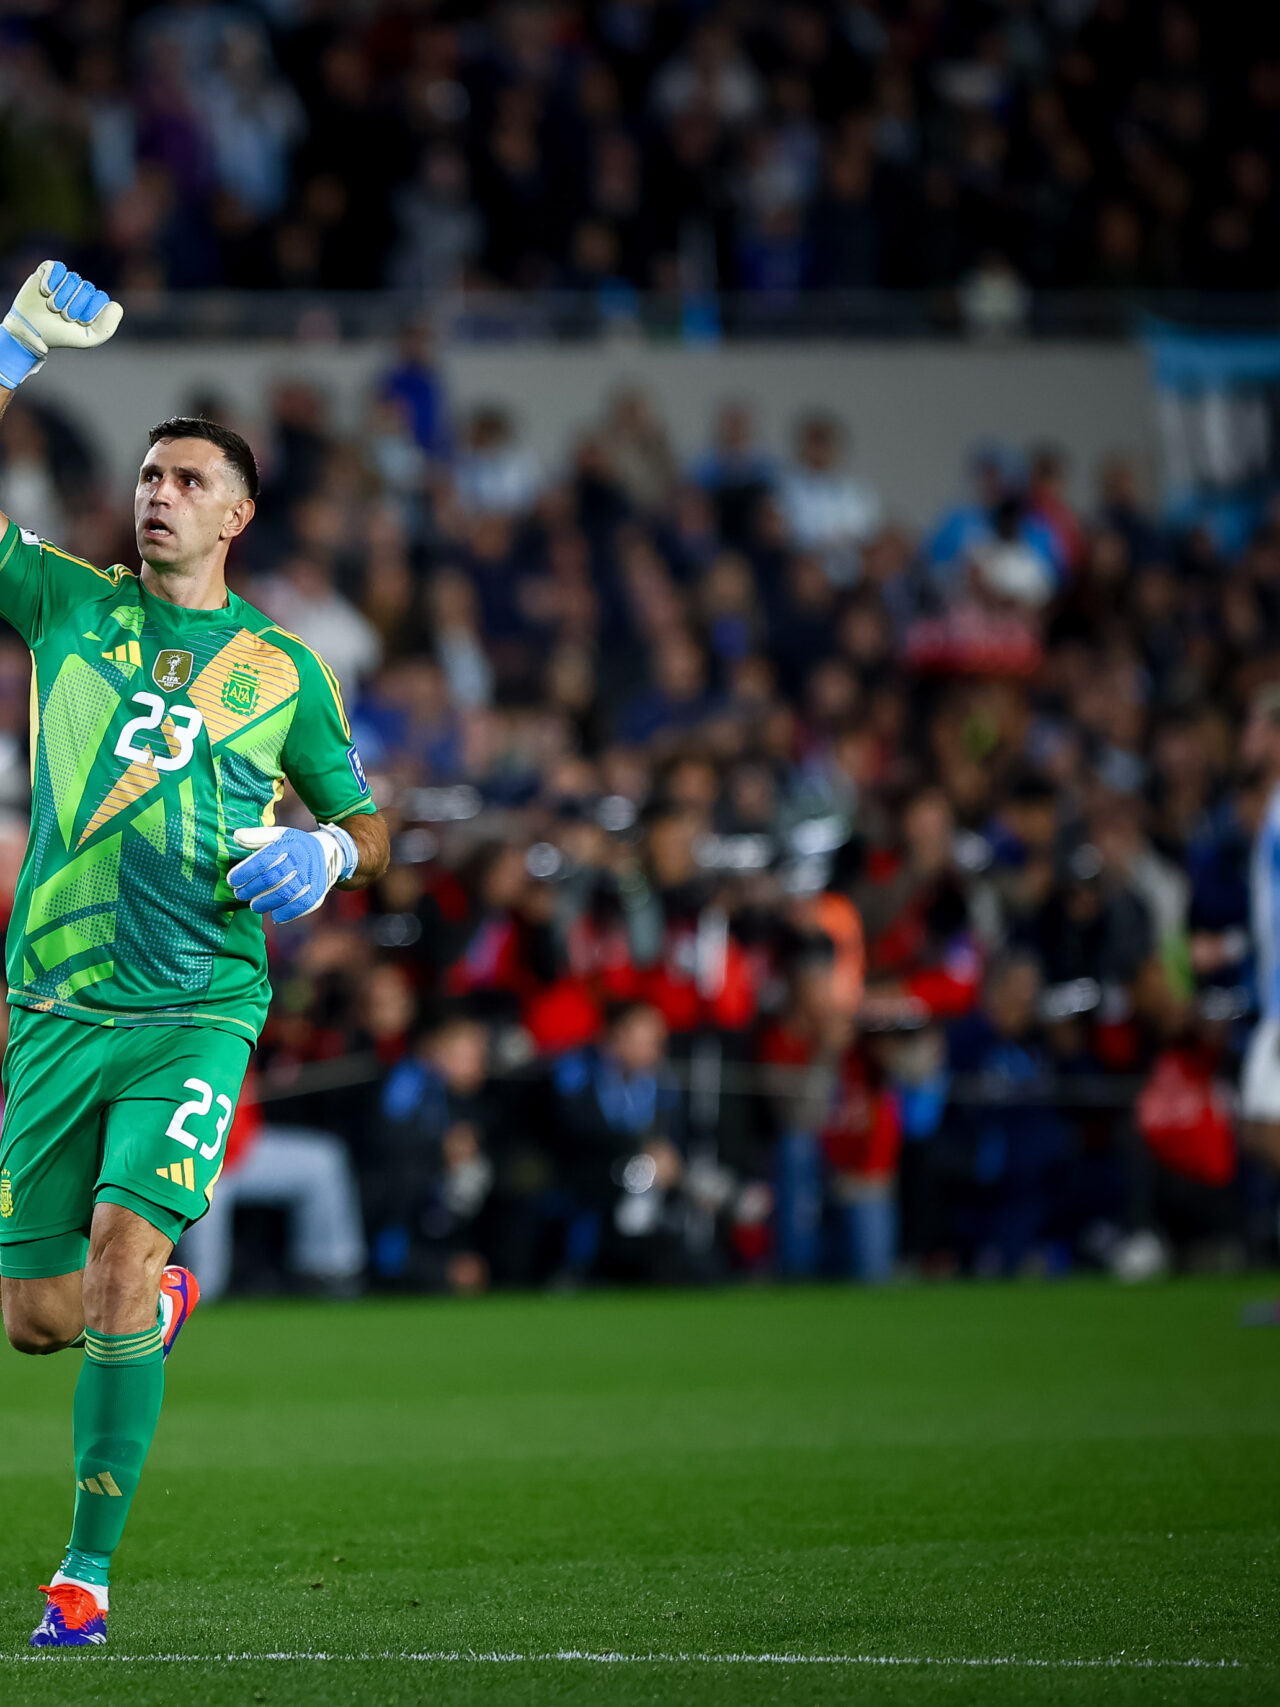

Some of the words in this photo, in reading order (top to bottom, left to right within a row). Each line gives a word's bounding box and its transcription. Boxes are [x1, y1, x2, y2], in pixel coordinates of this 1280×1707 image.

[162, 675, 179, 683] FIFA
[229, 681, 250, 704] AFA
[115, 692, 203, 771] 23
[166, 1079, 232, 1160] 23
